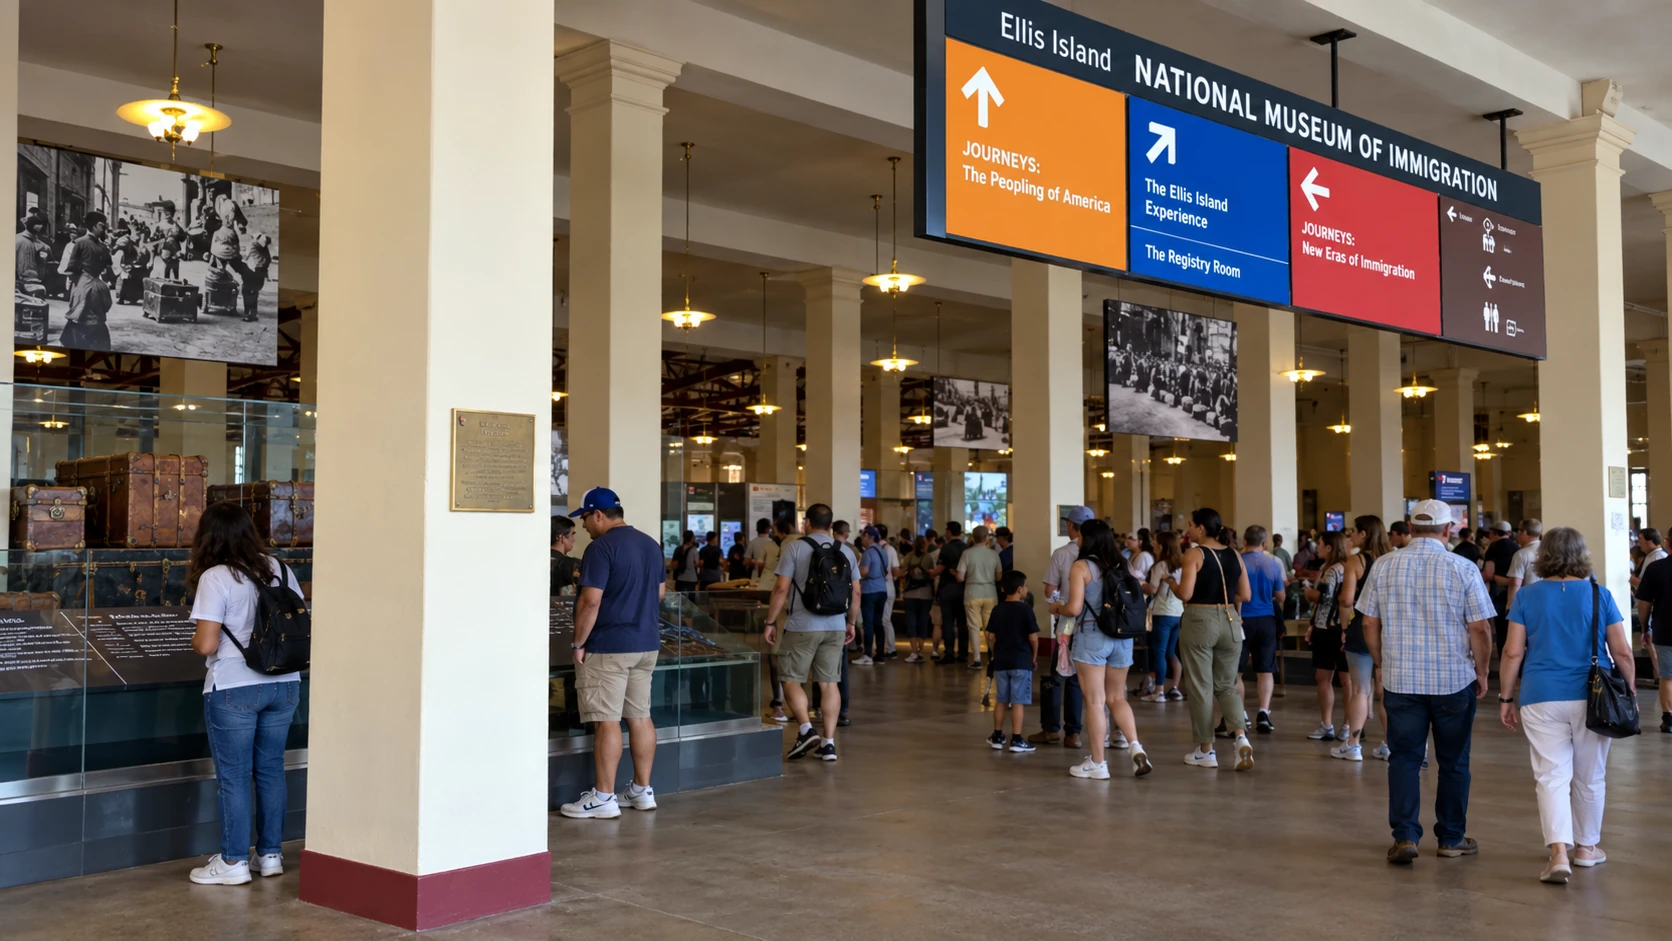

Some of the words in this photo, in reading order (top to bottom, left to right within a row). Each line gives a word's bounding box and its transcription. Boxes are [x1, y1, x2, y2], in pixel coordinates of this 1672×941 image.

[1002, 12, 1046, 50] Ellis
[1052, 29, 1111, 72] Island
[1136, 54, 1258, 122] NATIONAL
[1265, 99, 1352, 154] MUSEUM
[1359, 133, 1383, 162] OF
[1389, 143, 1498, 202] IMMIGRATION
[962, 140, 1041, 175] JOURNEYS:
[962, 163, 987, 185] The
[990, 171, 1045, 202] Peopling
[1047, 186, 1061, 202] of
[1063, 188, 1111, 214] America
[1146, 178, 1166, 197] The
[1170, 185, 1193, 204] Ellis
[1195, 191, 1228, 213] Island
[1146, 200, 1208, 229] Experience
[1301, 221, 1356, 247] JOURNEYS:
[1146, 244, 1166, 262] The
[1169, 249, 1211, 275] Registry
[1213, 260, 1241, 279] Room
[1301, 240, 1324, 258] New
[1325, 245, 1347, 265] Eras
[1348, 253, 1359, 267] of
[1361, 254, 1416, 281] Immigration
